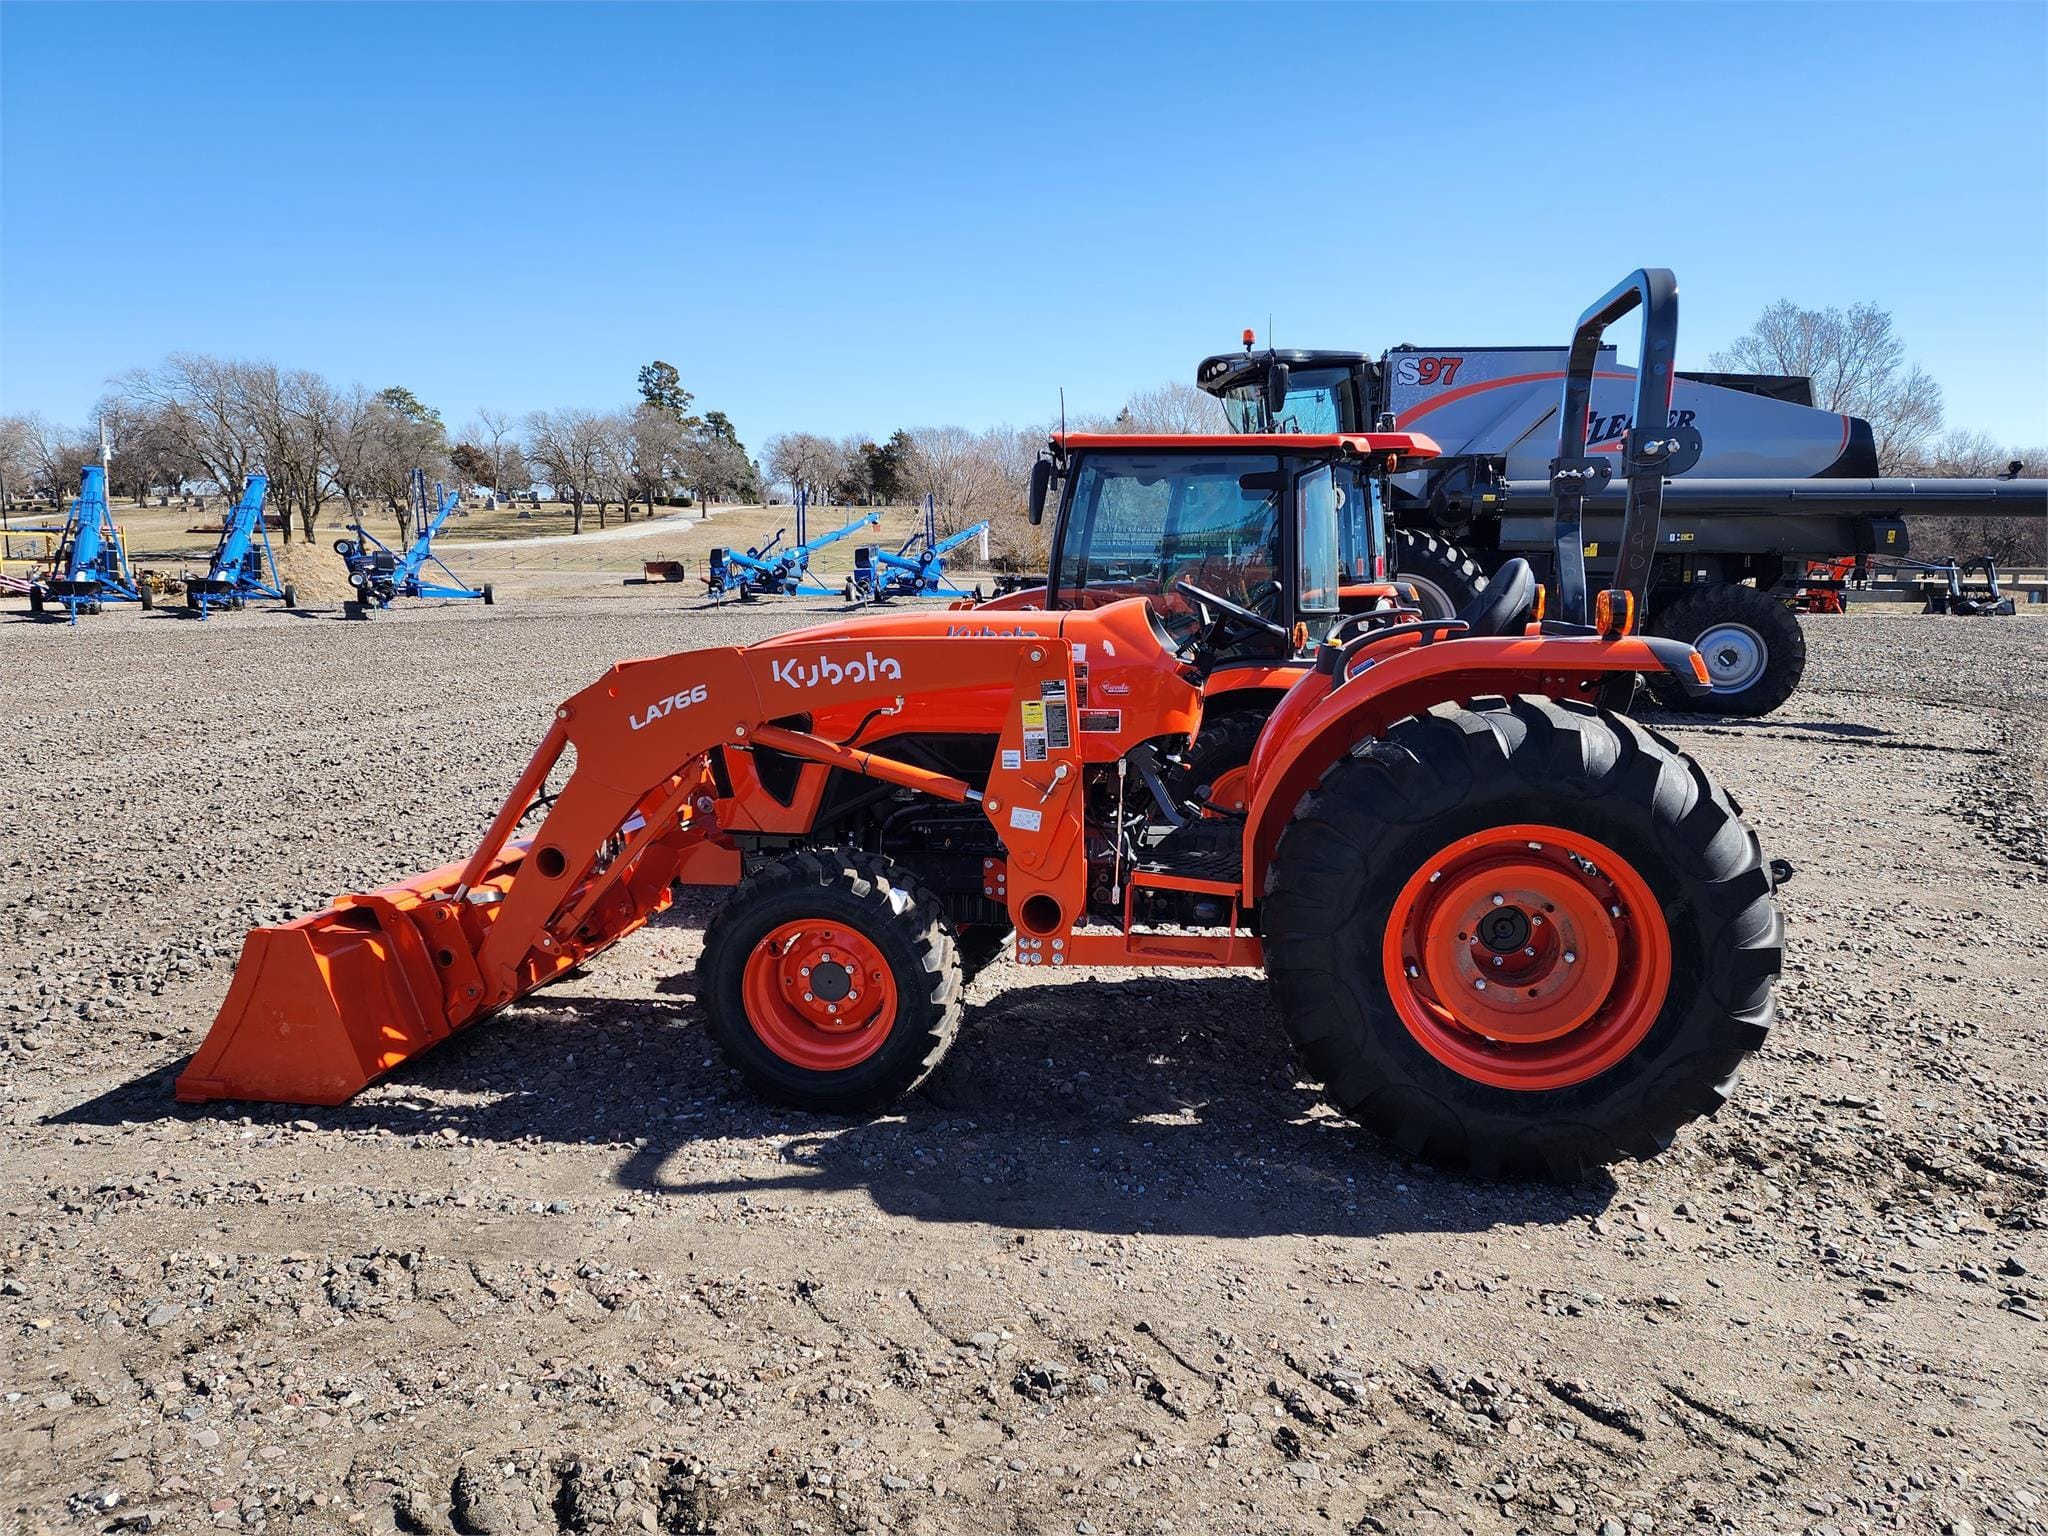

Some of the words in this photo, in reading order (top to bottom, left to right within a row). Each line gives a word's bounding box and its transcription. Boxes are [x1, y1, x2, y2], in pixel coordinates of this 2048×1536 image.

[1397, 357, 1463, 385] S97
[771, 652, 902, 688] Kubota
[628, 684, 708, 730] LA766
